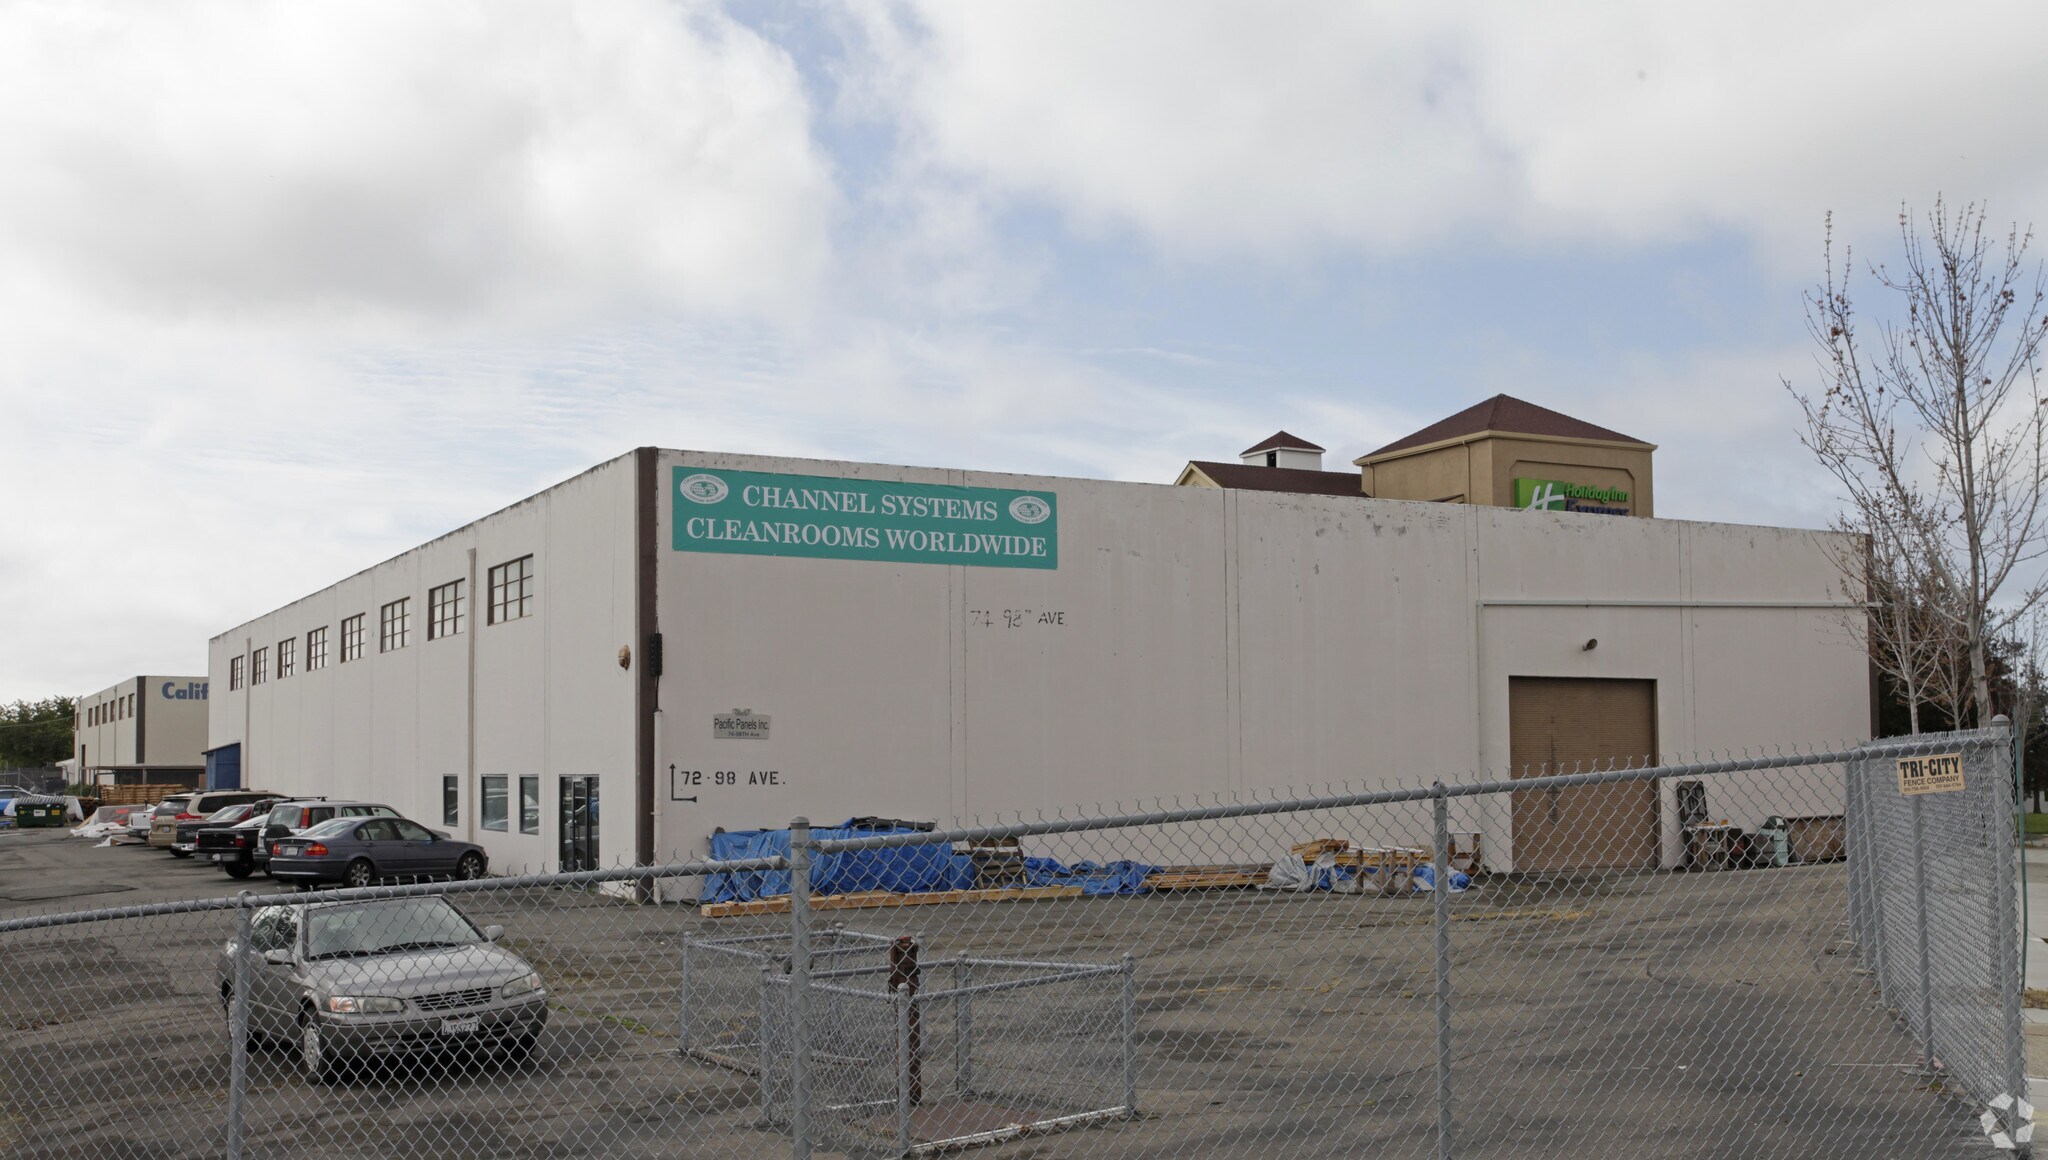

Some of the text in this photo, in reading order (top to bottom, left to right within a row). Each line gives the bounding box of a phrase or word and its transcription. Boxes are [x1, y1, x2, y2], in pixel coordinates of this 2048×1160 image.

[742, 484, 876, 515] CHANNEL
[881, 494, 998, 521] SYSTEMS
[1565, 482, 1629, 504] Holiday Inn
[686, 517, 1047, 557] CLEANROOMS WORLDWIDE
[162, 681, 208, 700] Calif
[714, 717, 770, 730] Pacific Panels Inc.
[1900, 757, 1959, 778] TRI-CITY
[748, 771, 786, 785] AVE.
[1904, 775, 1959, 786] FENCE COMPANY
